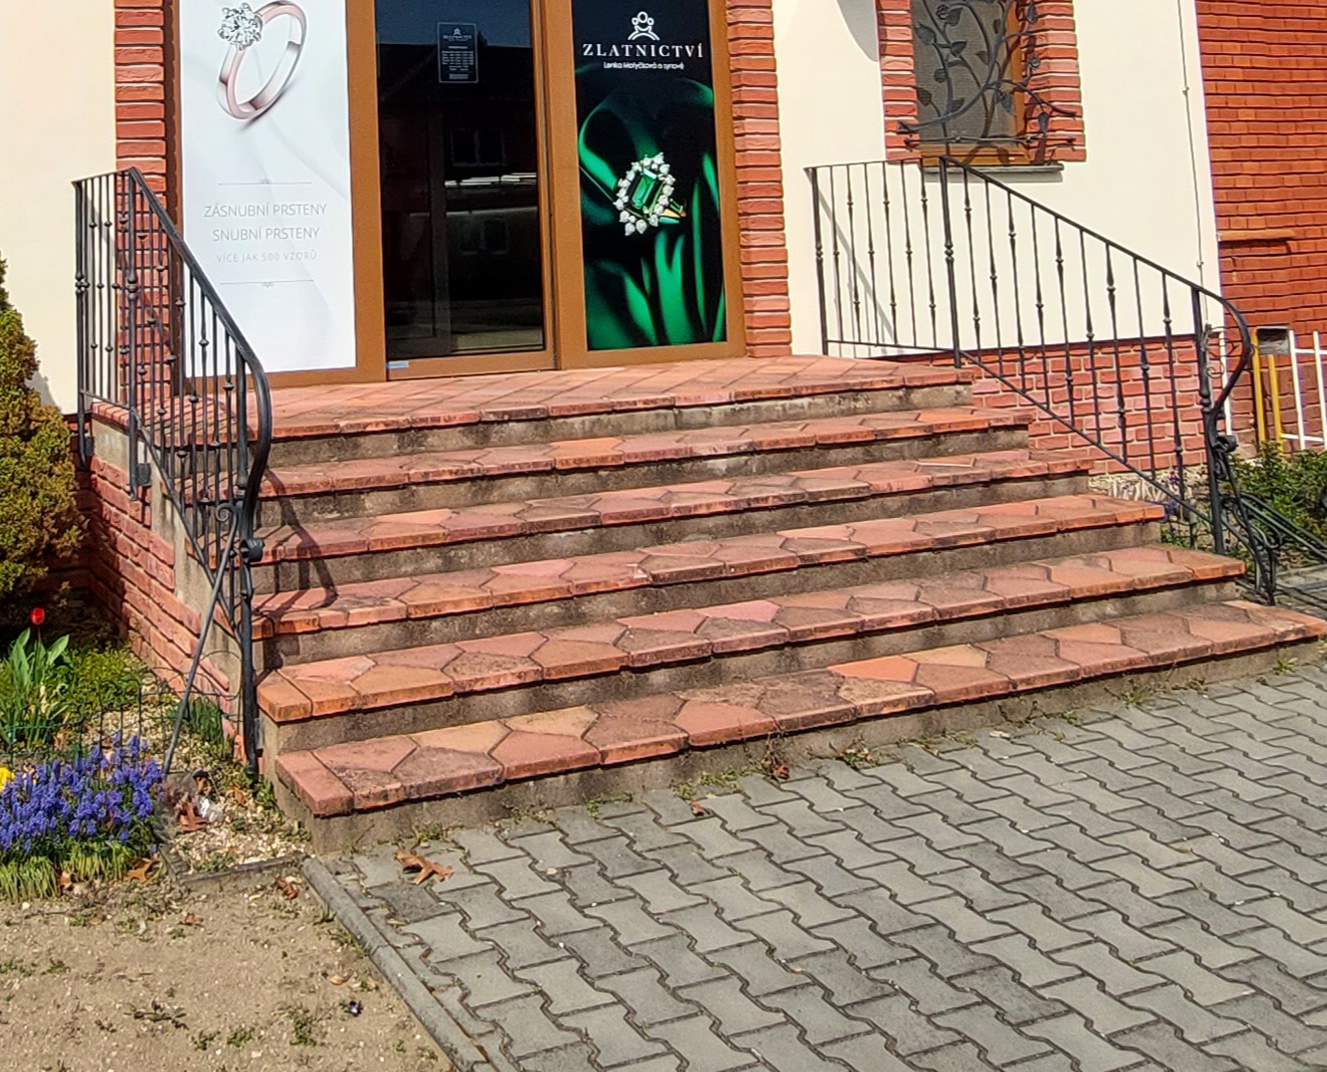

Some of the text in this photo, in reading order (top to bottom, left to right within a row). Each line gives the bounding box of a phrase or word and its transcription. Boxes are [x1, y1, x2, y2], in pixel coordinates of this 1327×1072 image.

[582, 42, 704, 58] ZLATNICTVÍ
[204, 202, 327, 218] ZÁSNUBNÍ PRSTENY
[212, 225, 320, 242] SNUBNÍ PRSTENY
[216, 249, 317, 263] VÍCE JAK 500 VZORŮ
